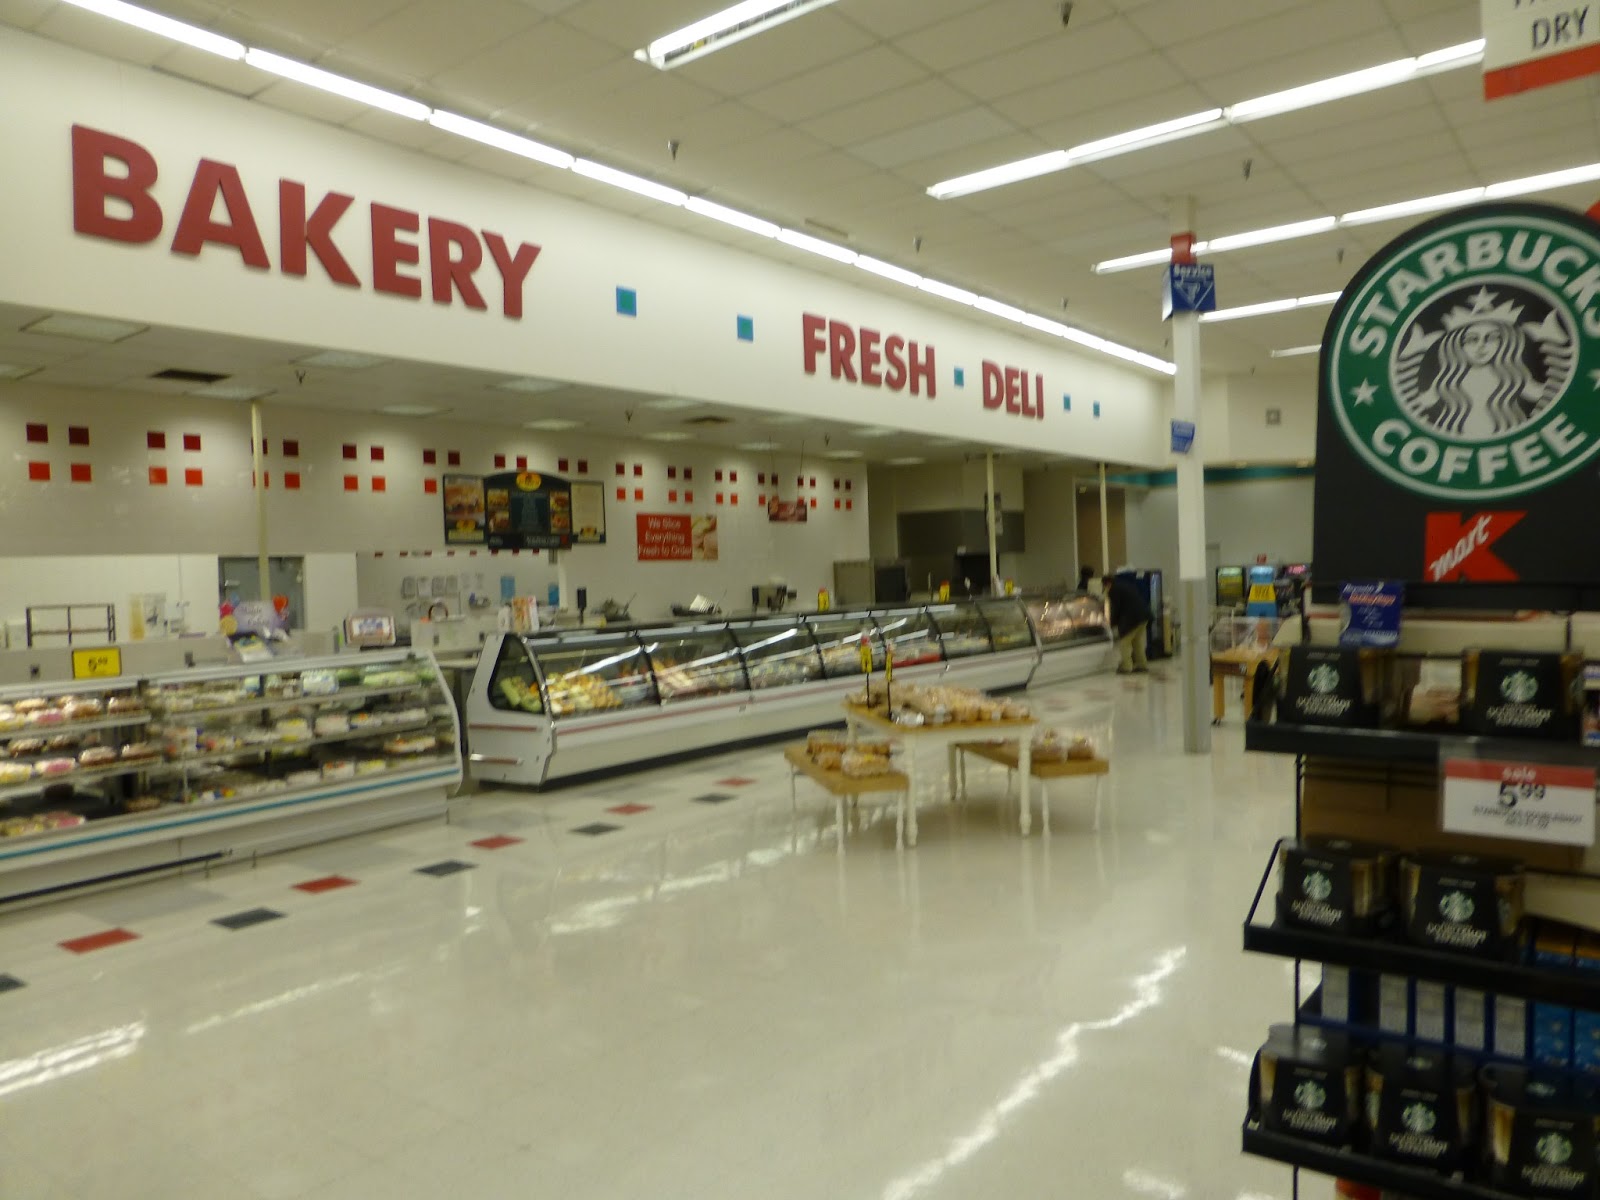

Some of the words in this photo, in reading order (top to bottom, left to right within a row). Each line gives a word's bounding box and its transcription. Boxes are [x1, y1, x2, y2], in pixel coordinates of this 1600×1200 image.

[1532, 6, 1588, 49] DRY
[72, 124, 541, 318] BAKERY
[803, 312, 936, 399] FRESH
[982, 359, 1044, 421] DELI
[1372, 412, 1588, 485] COFFEE
[645, 530, 684, 545] Everything
[648, 517, 660, 529] We
[662, 517, 681, 530] Slice
[638, 545, 660, 556] Fresh
[671, 545, 691, 556] Order
